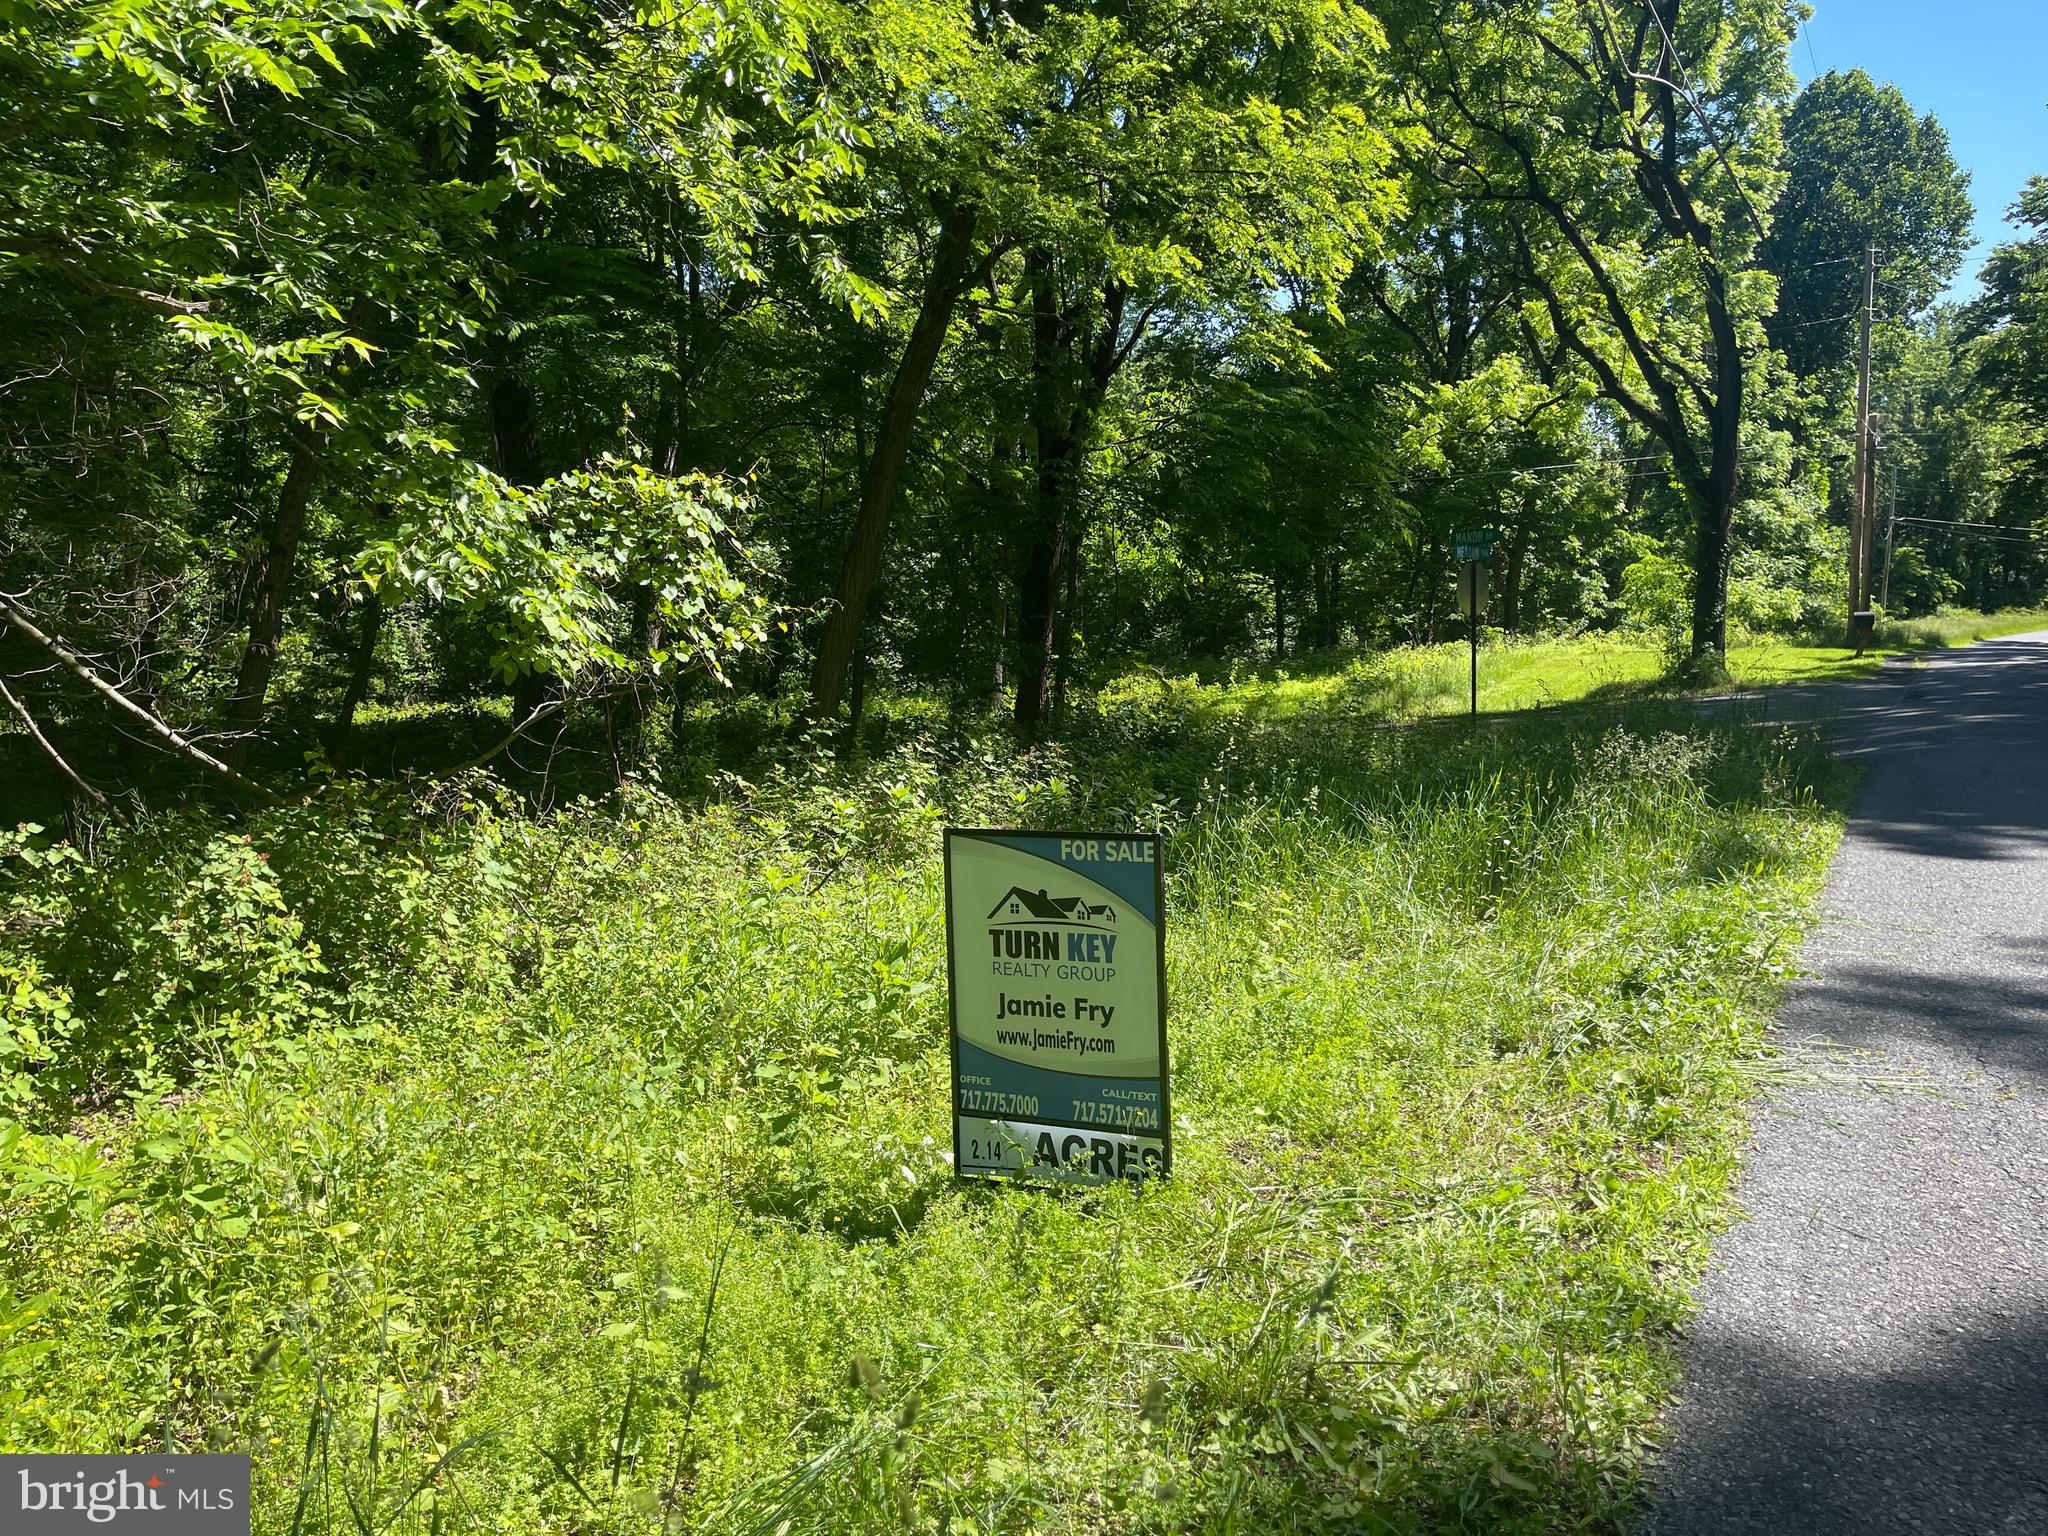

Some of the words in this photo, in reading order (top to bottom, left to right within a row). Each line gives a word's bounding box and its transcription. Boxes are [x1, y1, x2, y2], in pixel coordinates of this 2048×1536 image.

[1456, 531, 1483, 544] MANOR
[1061, 839, 1099, 862] FOR
[1105, 840, 1155, 863] SALE
[988, 929, 1060, 961] TURN
[1067, 932, 1117, 964] KEY
[992, 961, 1051, 978] REALTY
[1057, 965, 1116, 982] GROUP
[996, 992, 1066, 1020] Jamie
[1074, 997, 1115, 1029] Fry
[996, 1028, 1115, 1057] www.JamieFry.com
[959, 1074, 992, 1086] OFFICE
[960, 1089, 1039, 1117] 717.775.7000
[1102, 1088, 1158, 1102] CALL/TEXT
[971, 1139, 1001, 1161] 2.14
